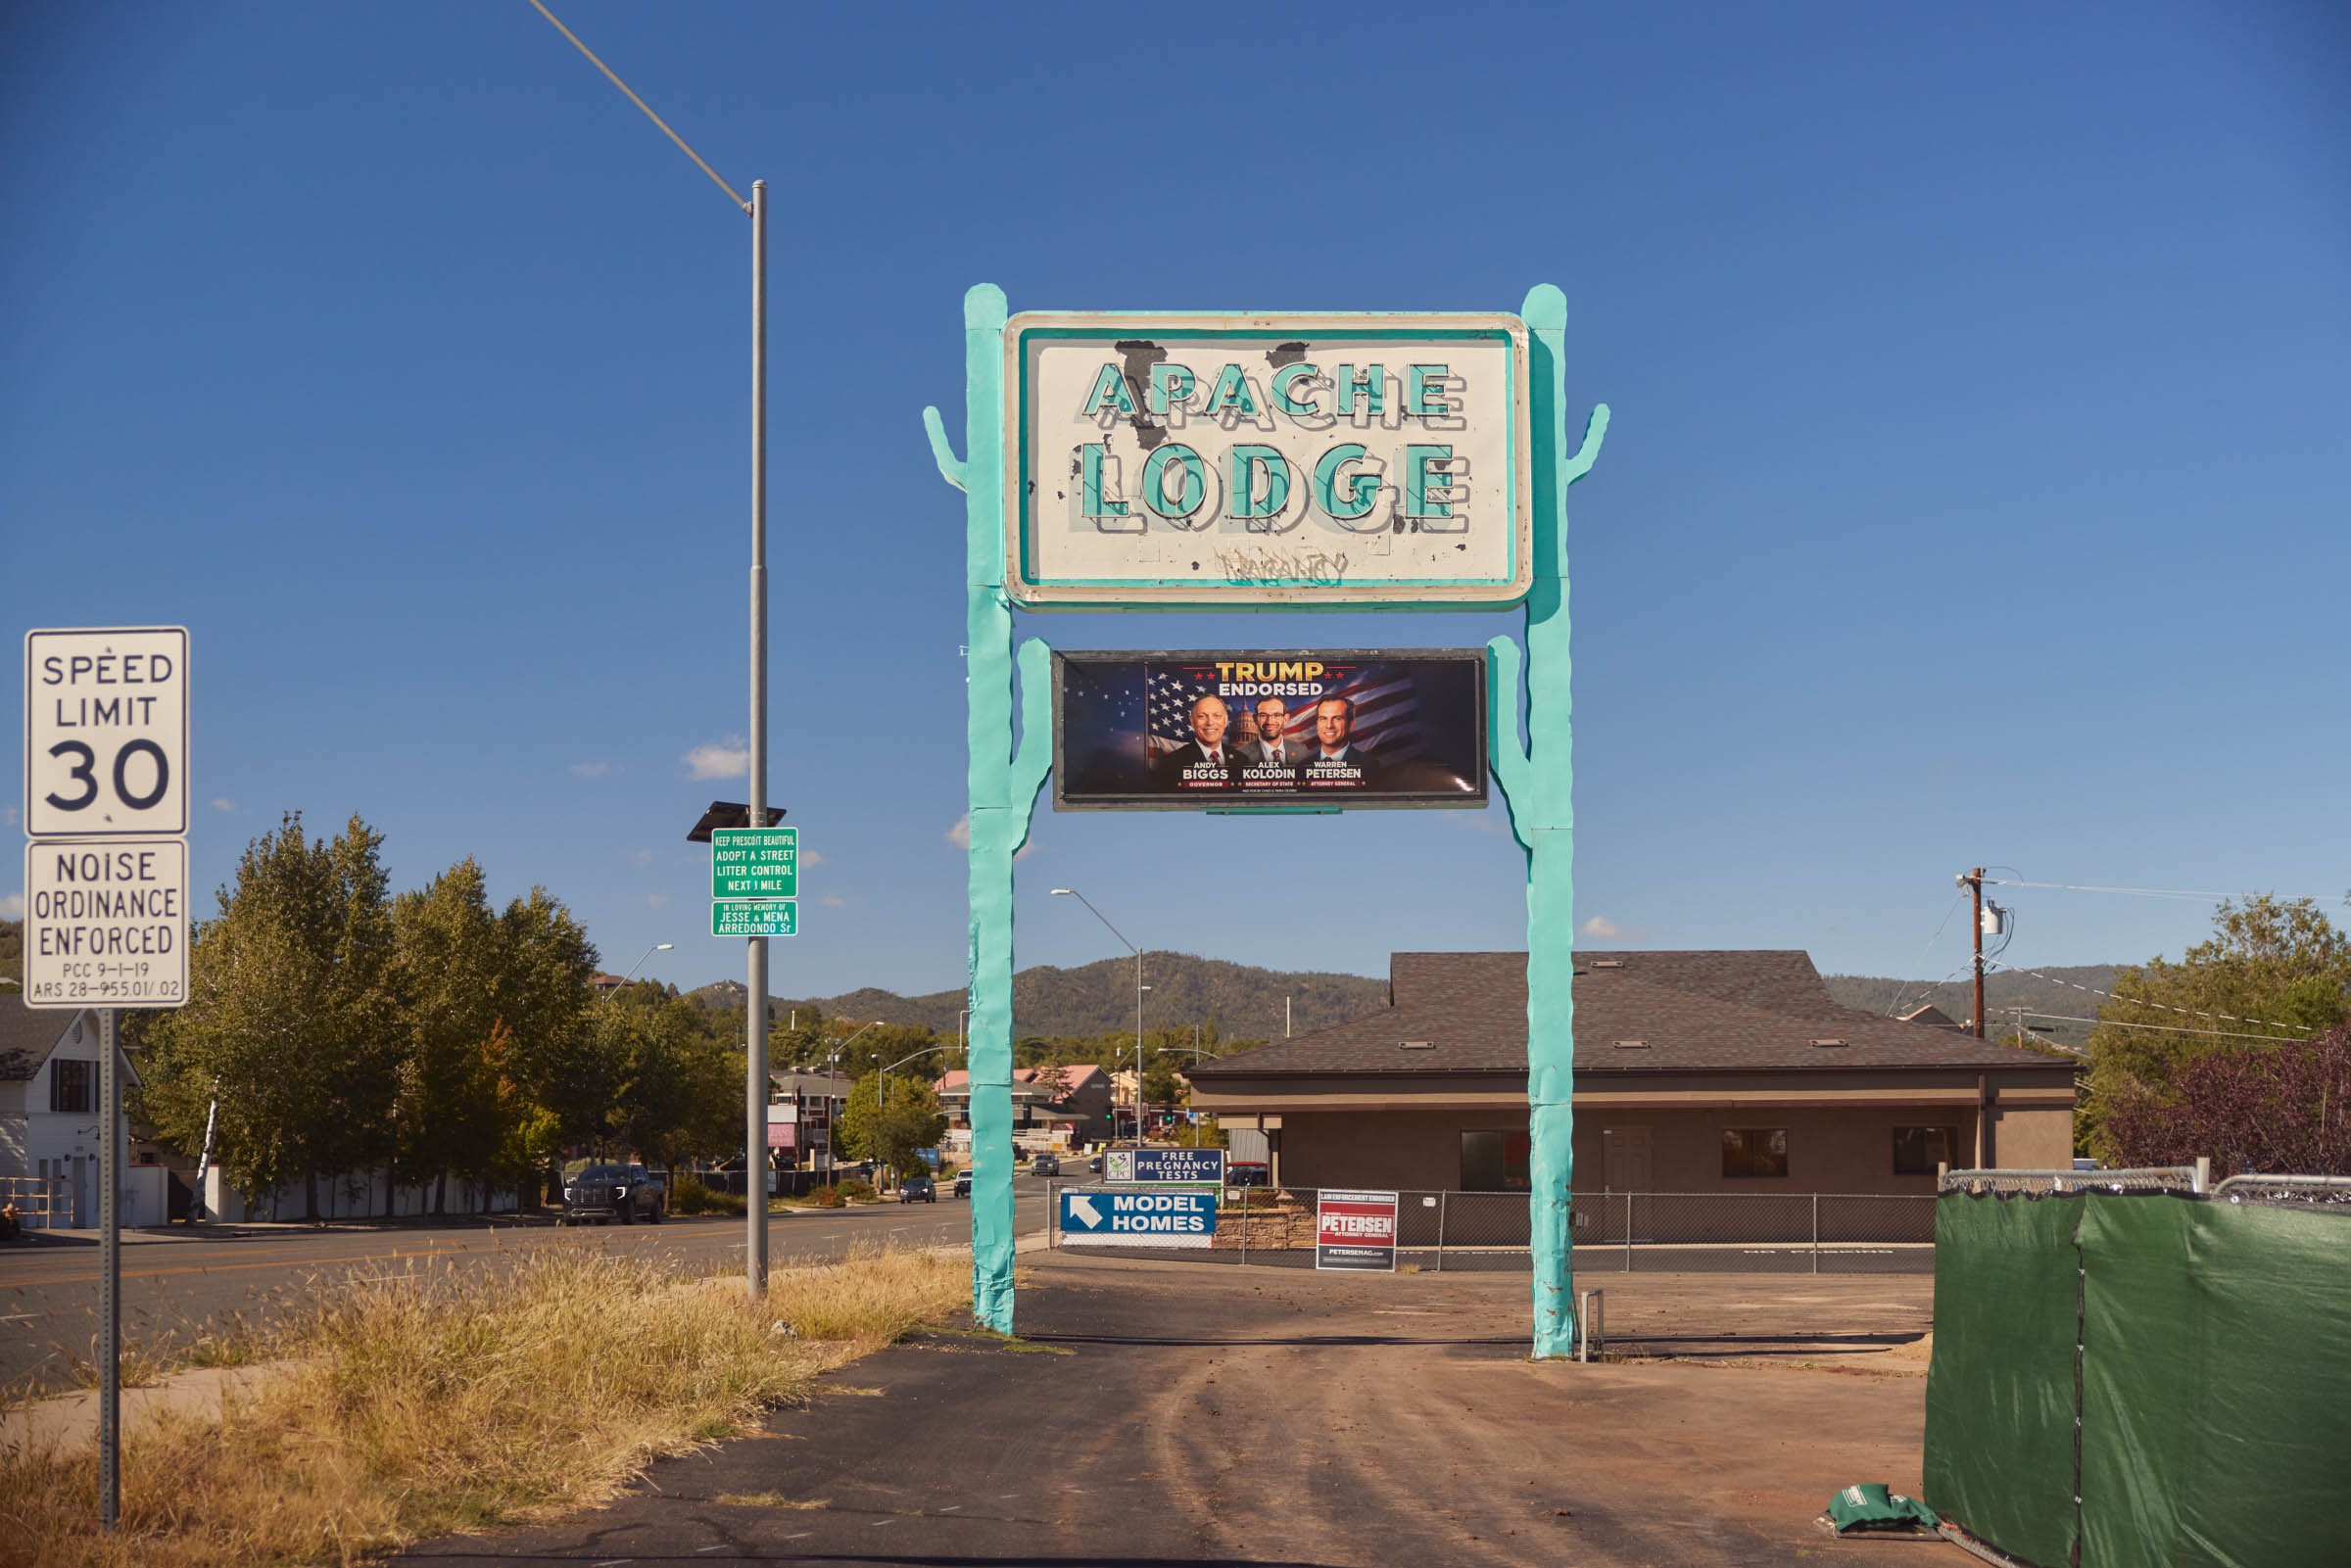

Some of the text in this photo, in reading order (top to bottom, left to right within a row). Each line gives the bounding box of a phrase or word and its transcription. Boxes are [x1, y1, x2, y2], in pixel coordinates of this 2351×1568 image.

[1082, 362, 1451, 416] APACHE
[1080, 443, 1454, 519] LODGE
[42, 654, 172, 685] SPEED
[1216, 662, 1324, 682] TRUMP
[1219, 683, 1323, 696] ENDORSED
[56, 697, 157, 727] LIMIT
[44, 738, 169, 811] 30
[1182, 769, 1229, 780] BIGGS
[1242, 769, 1296, 780] KOLODIN
[1306, 768, 1362, 779] PETERSEN
[715, 835, 794, 846] KEEP PRESCOTT BEAUTIFUL
[716, 850, 794, 861] ADOPT A STREET
[57, 852, 156, 881] NOISE
[717, 866, 792, 876] LITTER CONTROL
[728, 880, 782, 891] NEXT 1 MILE
[35, 888, 177, 919] ORDINANCE
[720, 913, 749, 923] JESSE
[763, 912, 791, 922] MENA
[718, 923, 792, 933] ARREDONDO Sr
[40, 926, 172, 955] ENFORCED
[63, 962, 149, 977] PCC 9-1-19
[33, 982, 63, 997] ARS
[1162, 1152, 1194, 1161] FREE
[1137, 1161, 1219, 1170] PREGNANCY
[1157, 1170, 1198, 1179] TESTS
[1113, 1196, 1204, 1212] MODEL
[1112, 1215, 1205, 1231] HOMES
[1321, 1214, 1392, 1233] PETERSEN
